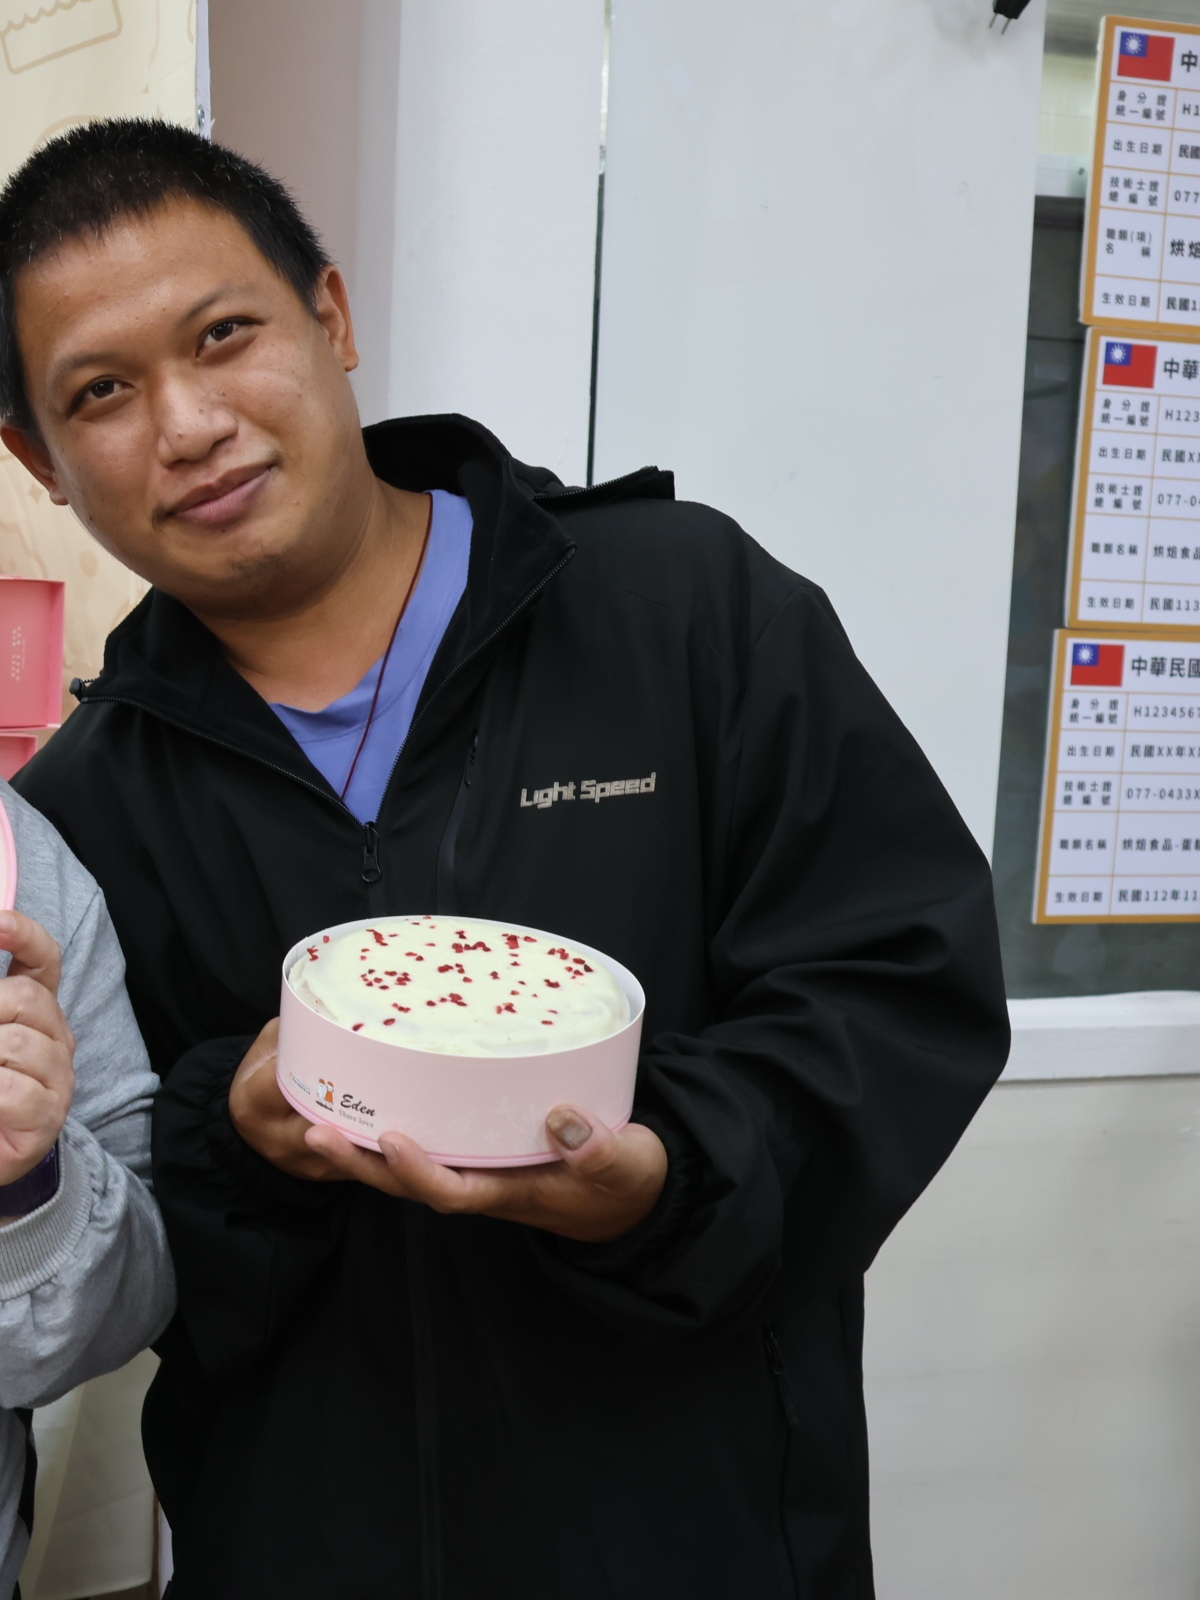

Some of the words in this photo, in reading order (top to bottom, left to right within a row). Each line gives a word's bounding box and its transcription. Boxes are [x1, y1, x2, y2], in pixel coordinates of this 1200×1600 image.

[1113, 139, 1163, 156] 出生日期
[1167, 297, 1200, 312] 民國1
[1165, 409, 1200, 423] H123
[1098, 446, 1146, 461] 出生日期
[1157, 493, 1200, 507] 077-0
[1131, 655, 1200, 678] 中華民國
[1067, 745, 1116, 757] 出生日期
[520, 781, 576, 809] Light
[580, 771, 657, 804] Speed
[340, 1094, 376, 1117] Eden
